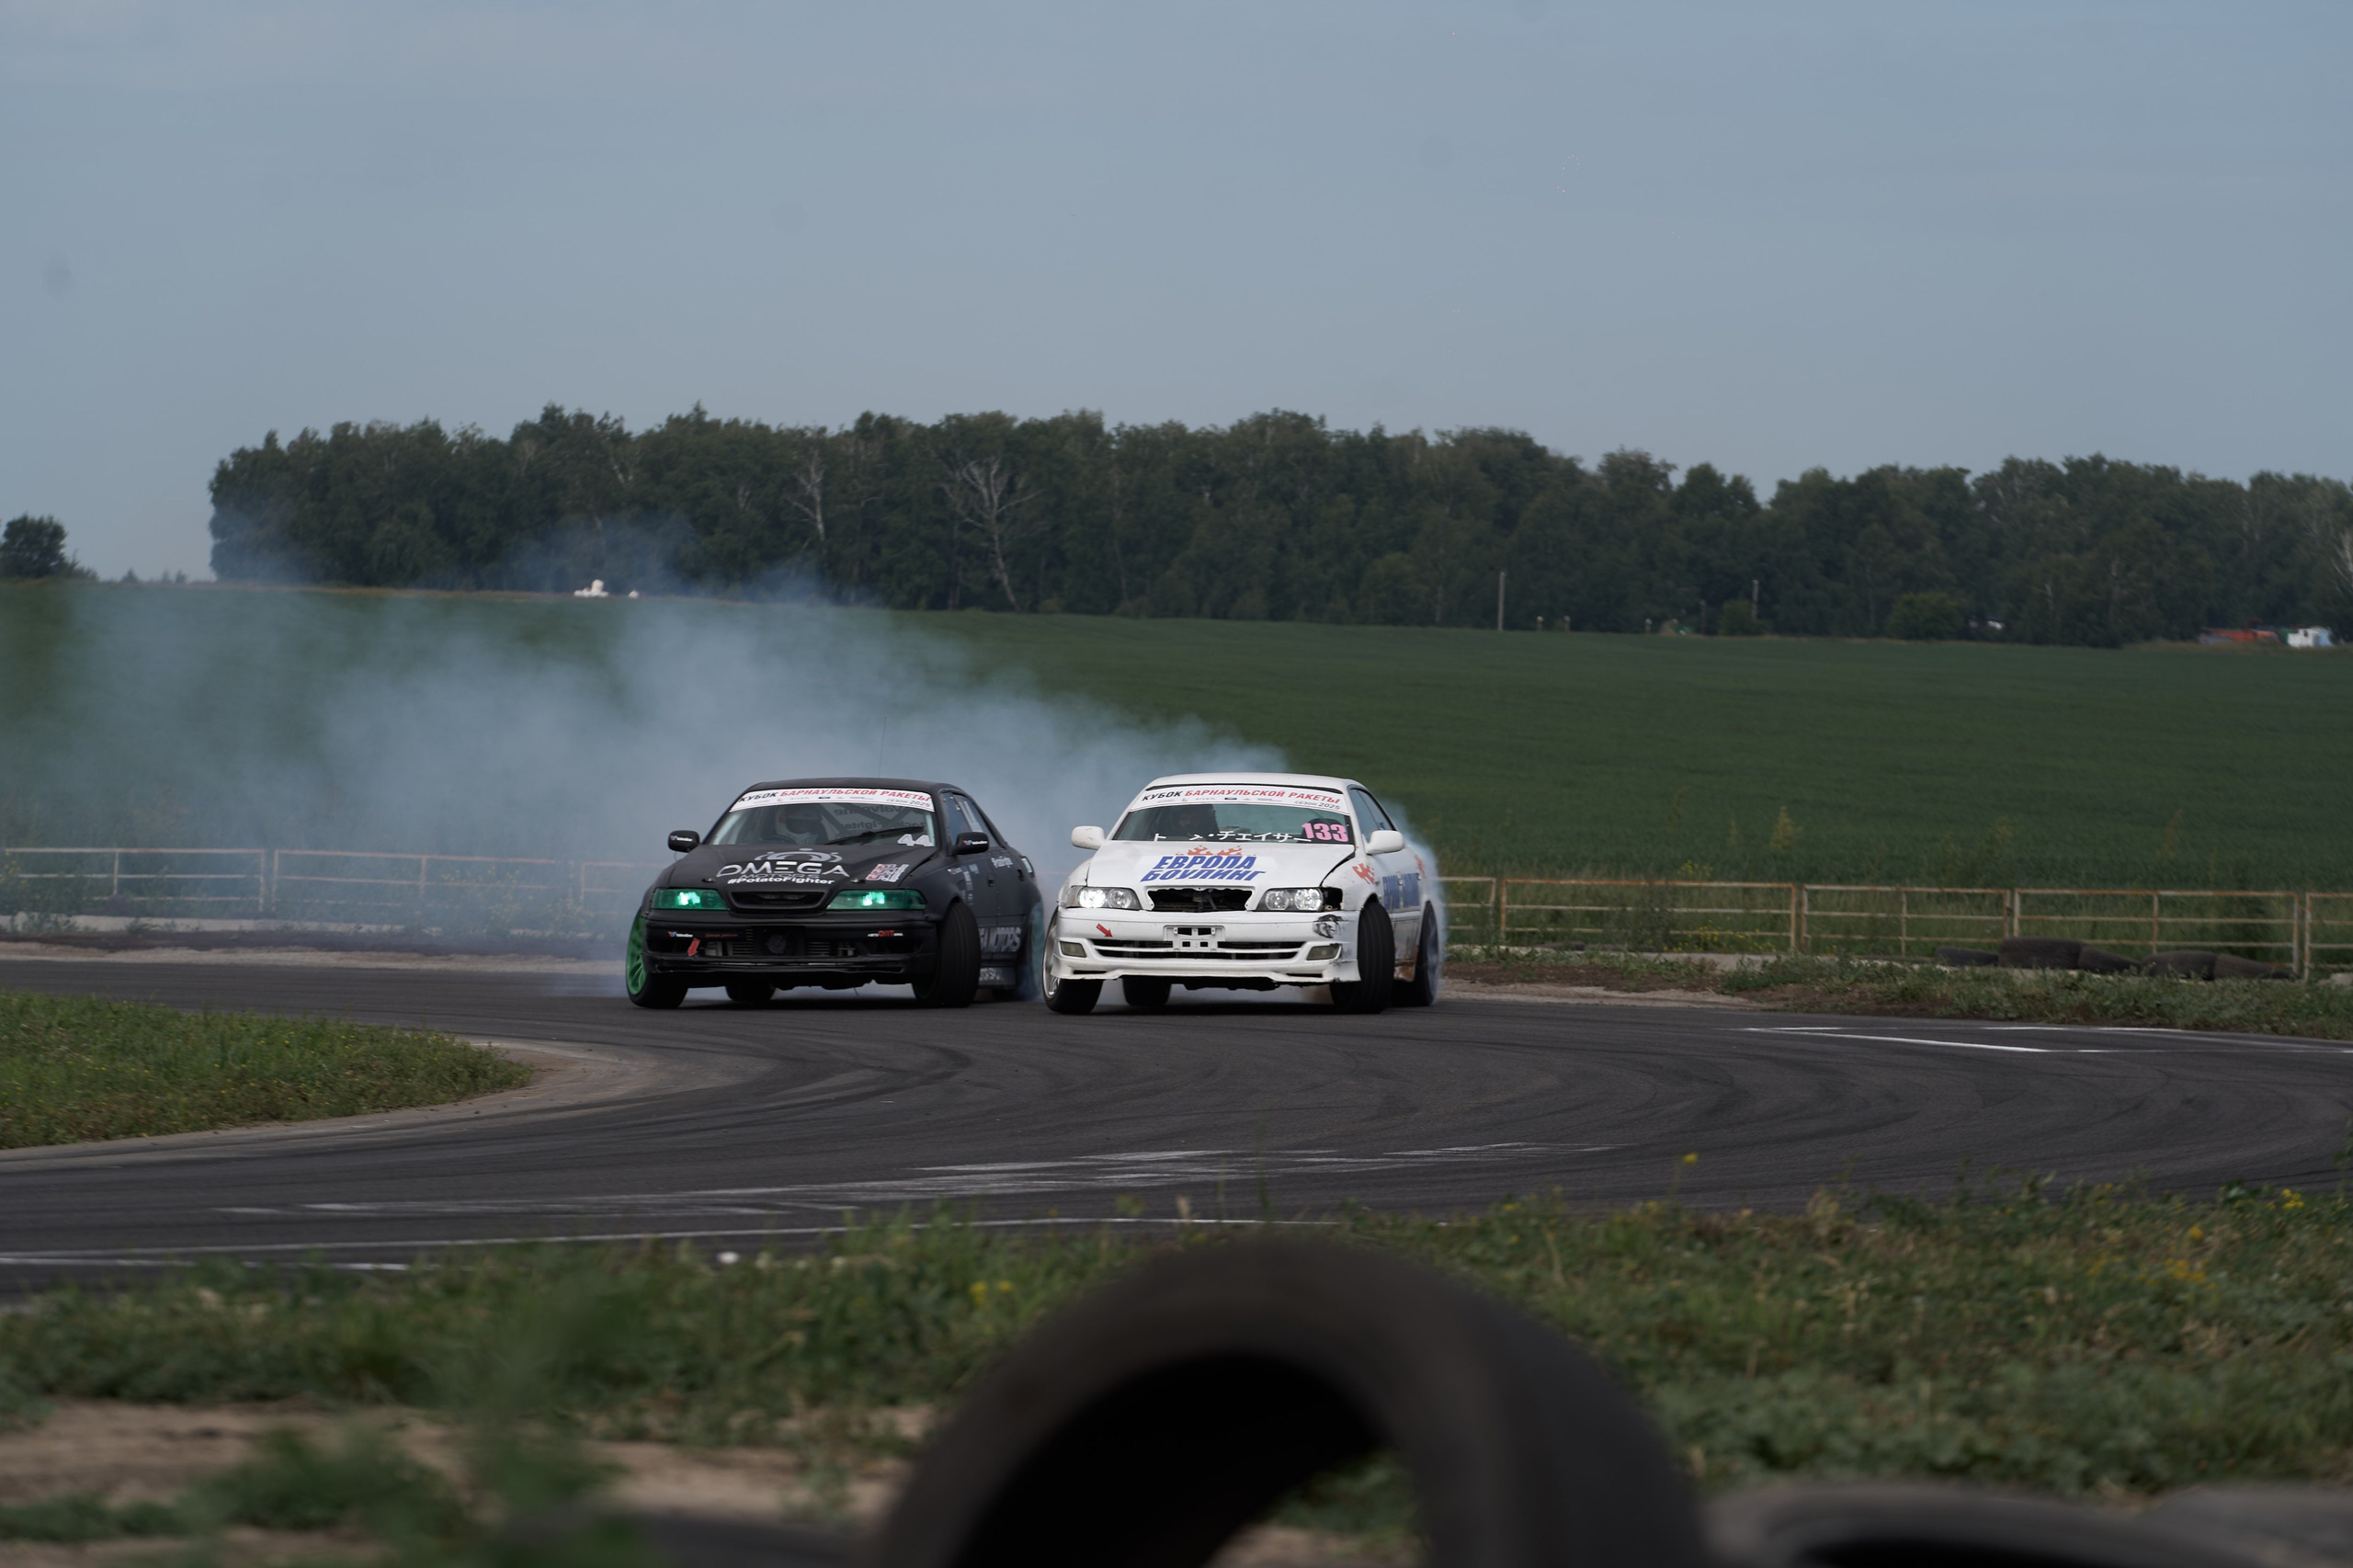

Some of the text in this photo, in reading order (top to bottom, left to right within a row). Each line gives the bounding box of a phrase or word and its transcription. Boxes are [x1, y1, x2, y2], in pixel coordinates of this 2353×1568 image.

[739, 792, 779, 802] КУБОК
[881, 790, 931, 801] РАКЕТЫ
[1142, 790, 1183, 801] КУБОК
[1289, 791, 1340, 803] РАКЕТЫ
[1319, 801, 1340, 810] 2025
[1302, 823, 1349, 843] 133
[897, 834, 936, 846] 44
[1153, 856, 1256, 869] ЕВРОПА
[716, 861, 850, 878] OMEGA
[1140, 869, 1267, 882] БОУЛИНГ
[727, 876, 835, 884] #PotatoFighter
